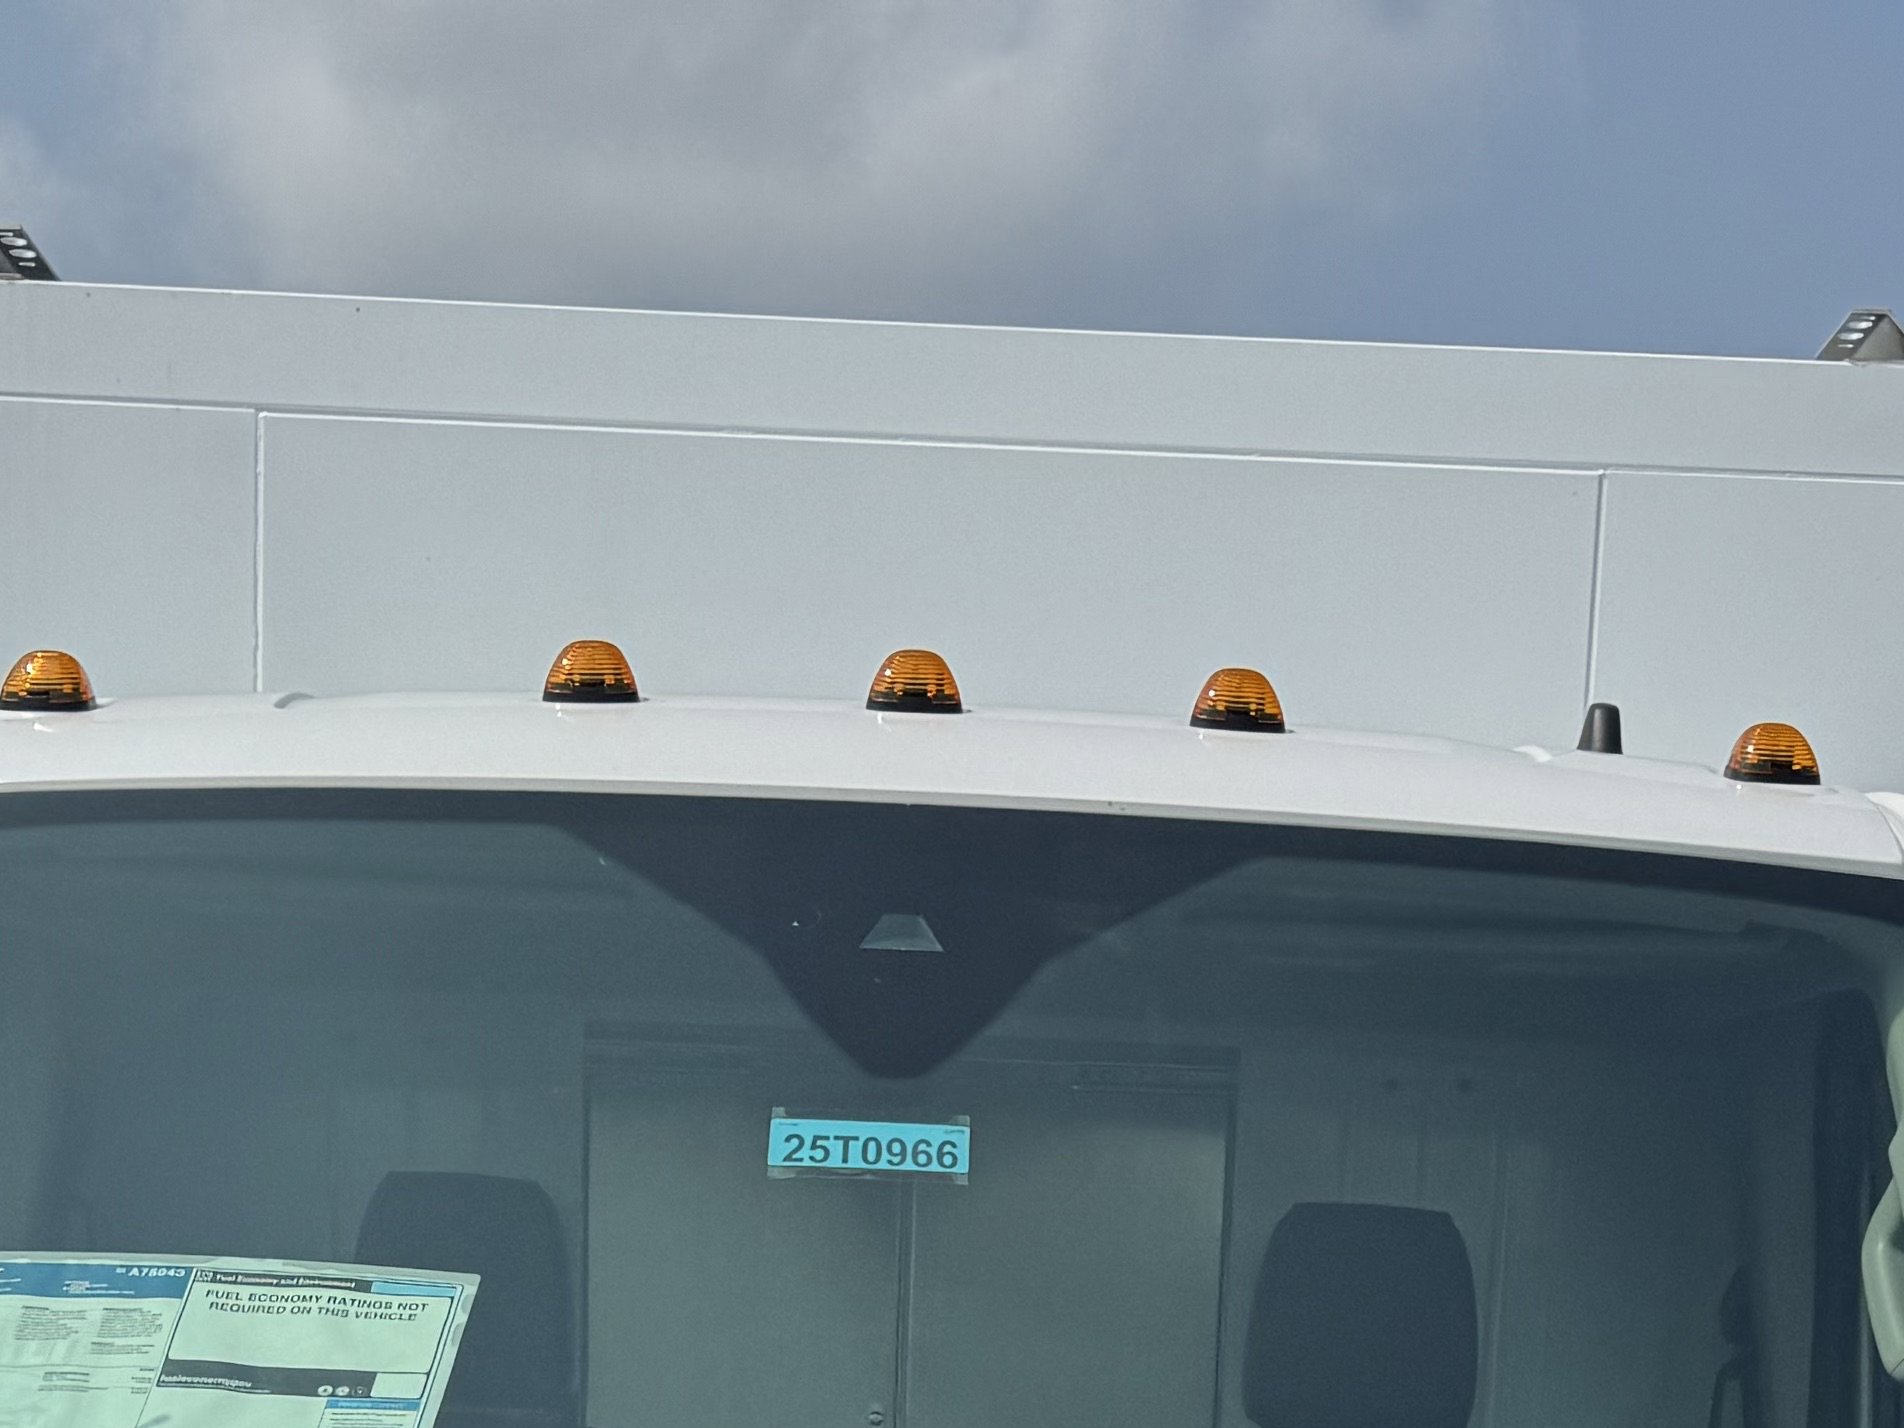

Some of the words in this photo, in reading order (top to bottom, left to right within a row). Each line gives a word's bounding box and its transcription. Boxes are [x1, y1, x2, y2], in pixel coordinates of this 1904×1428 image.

[782, 1133, 959, 1168] 25T0966
[206, 1289, 243, 1302] FUEL
[248, 1293, 324, 1305] ECONOMY
[327, 1295, 395, 1310] RATINGS
[397, 1302, 430, 1313] NOT
[209, 1301, 286, 1315] REQUIRED
[290, 1305, 313, 1316] ON
[317, 1307, 349, 1318] THIS
[355, 1310, 419, 1322] VEHICLE
